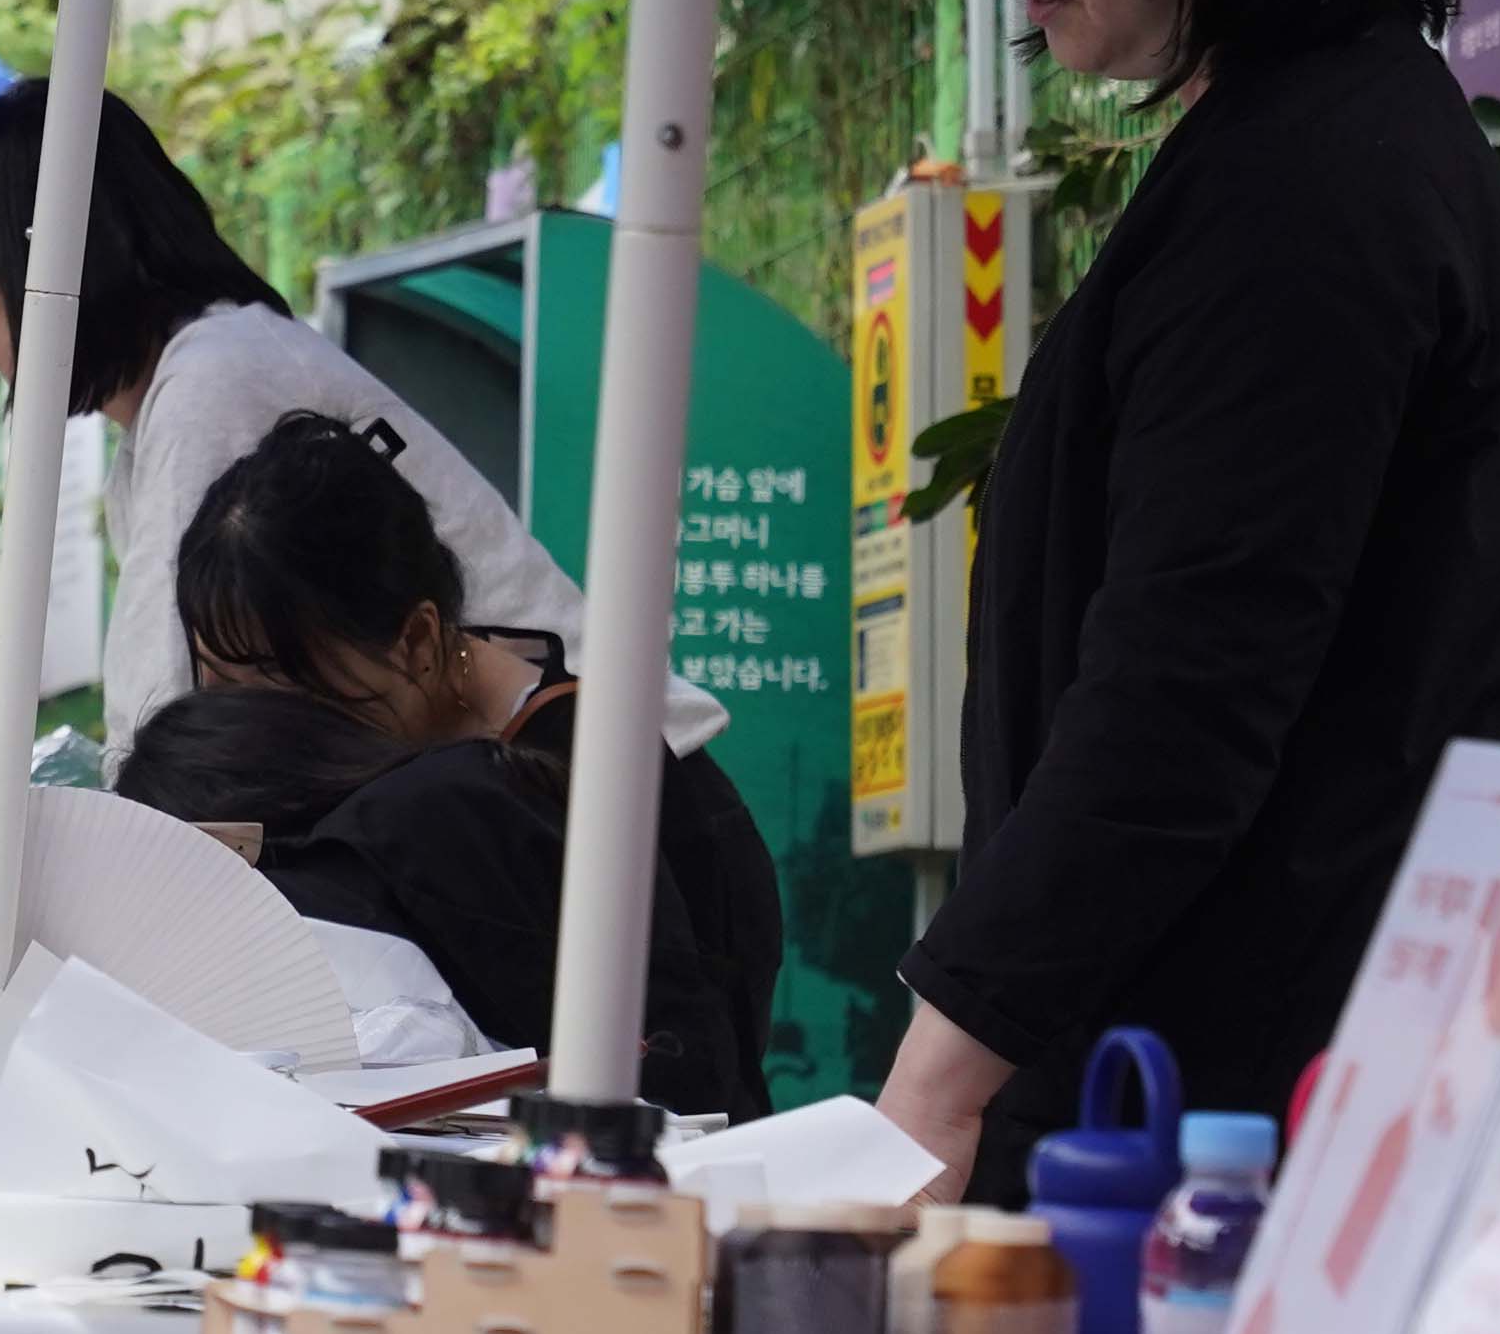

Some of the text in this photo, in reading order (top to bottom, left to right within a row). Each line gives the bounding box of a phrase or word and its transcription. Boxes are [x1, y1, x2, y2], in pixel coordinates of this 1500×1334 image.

[687, 465, 806, 504] 가슴 앞에
[675, 512, 770, 550] 그머니
[674, 558, 827, 600] 봉투 하나를
[668, 605, 772, 645] 고 가는
